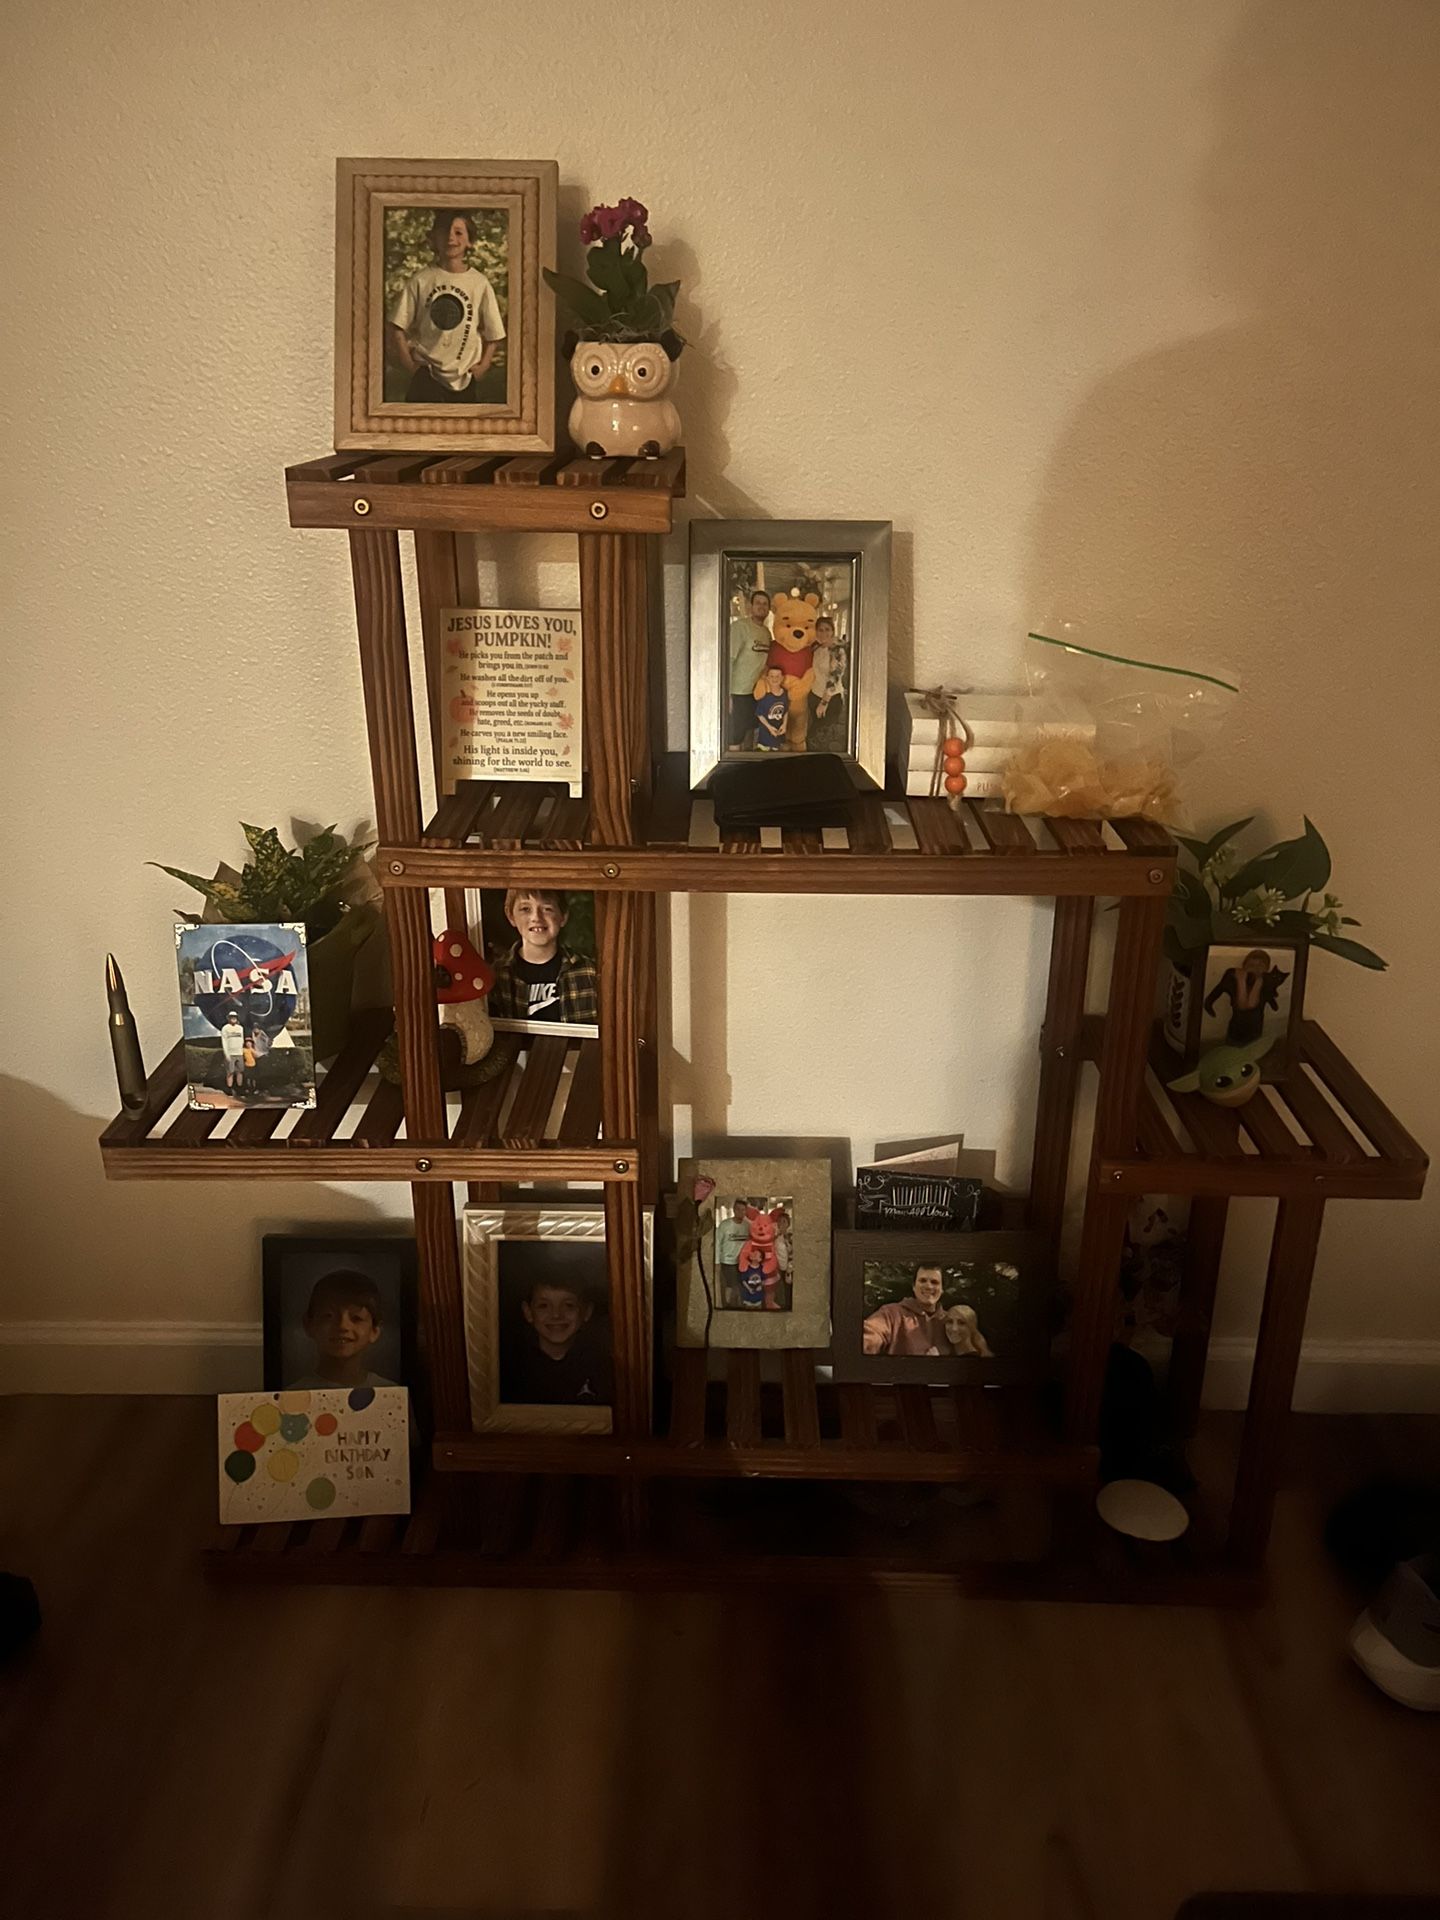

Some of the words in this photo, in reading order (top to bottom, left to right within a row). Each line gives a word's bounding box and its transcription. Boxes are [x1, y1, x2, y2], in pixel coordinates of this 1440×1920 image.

[450, 285, 469, 302] YOUR
[447, 615, 491, 632] JESUS
[495, 615, 539, 629] LOVES
[543, 617, 576, 636] YOU,
[474, 632, 551, 648] PUMPKIN!
[459, 651, 468, 659] He
[470, 651, 488, 660] picks
[490, 653, 503, 661] you
[504, 651, 520, 660] from
[522, 651, 533, 659] the
[534, 652, 553, 661] patch
[555, 652, 568, 660] and
[478, 661, 500, 670] brings
[502, 662, 514, 670] you
[508, 674, 520, 682] the
[487, 690, 496, 698] He
[497, 691, 516, 699] opens
[517, 691, 529, 699] you
[509, 699, 517, 707] all
[529, 700, 548, 708] yucky
[469, 708, 478, 716] He
[517, 709, 534, 717] seeds
[535, 709, 541, 717] of
[494, 730, 506, 738] you
[527, 730, 552, 739] smiling
[553, 730, 568, 738] face.
[463, 745, 479, 754] His
[480, 745, 500, 756] light
[502, 745, 509, 754] is
[512, 745, 537, 755] inside
[539, 747, 558, 757] you,
[453, 756, 485, 767] shining
[487, 757, 500, 766] for
[502, 757, 516, 766] the
[518, 757, 543, 767] world
[545, 758, 554, 767] to
[555, 759, 572, 767] see.
[194, 968, 298, 995] NASA
[337, 1430, 381, 1445] HAPPY
[325, 1448, 391, 1463] BIRTHDAY
[346, 1465, 374, 1480] SON
